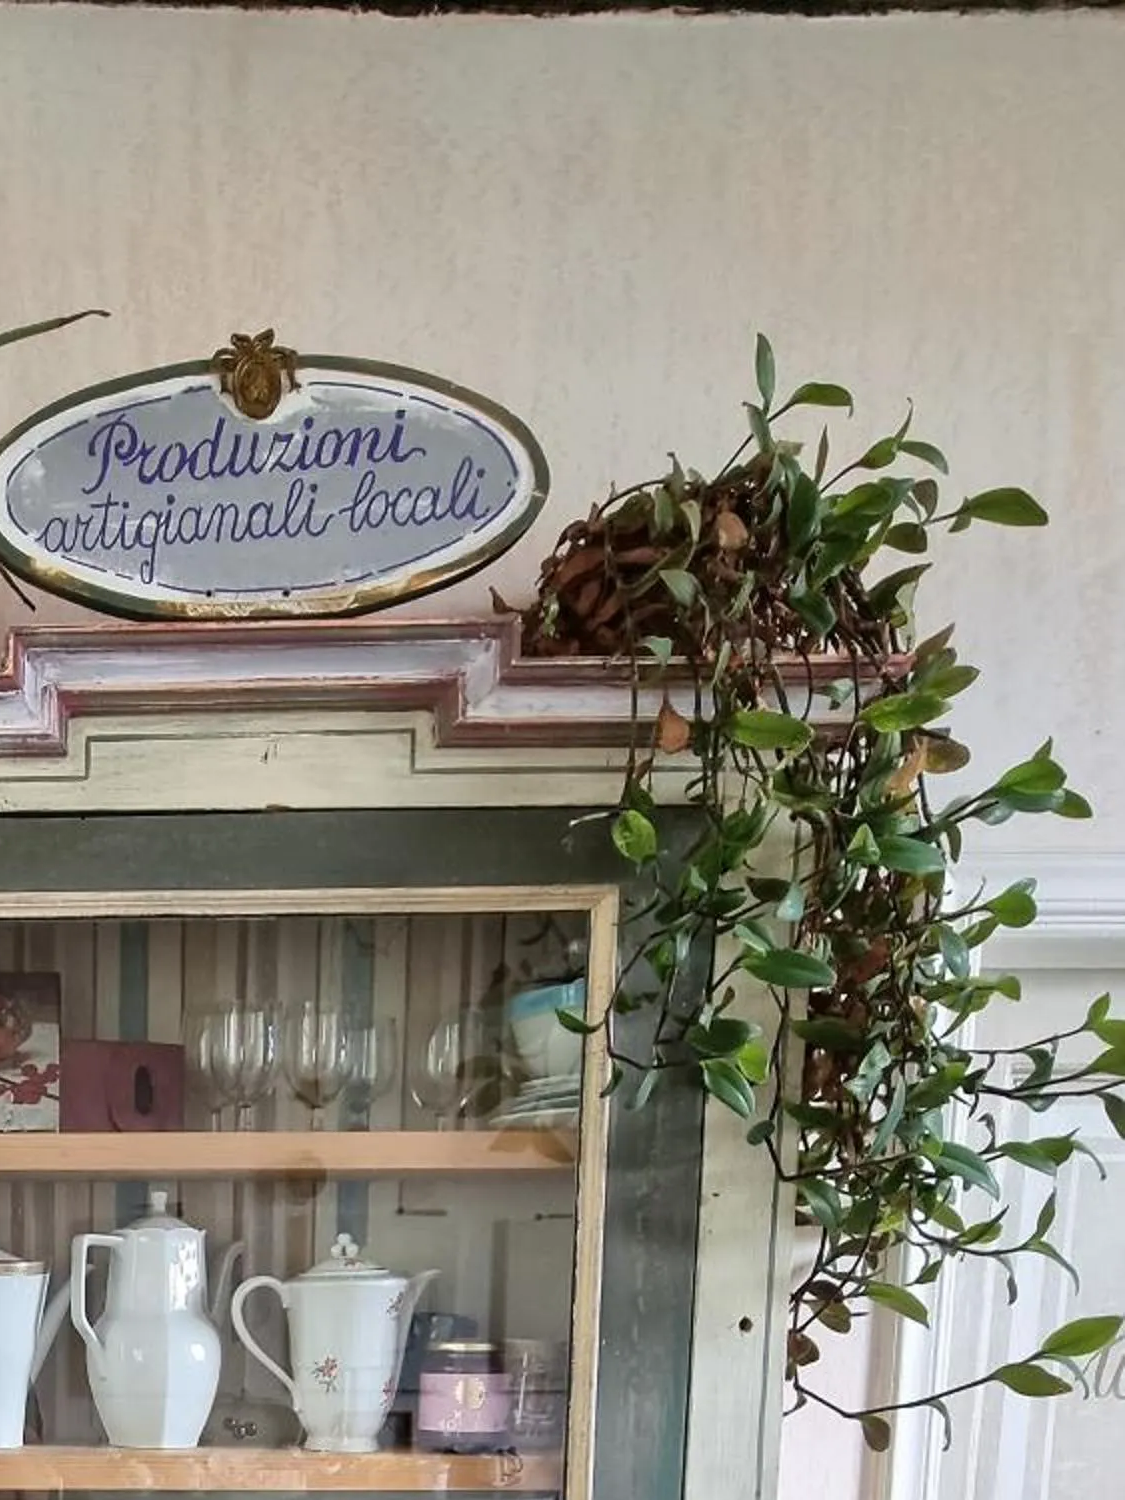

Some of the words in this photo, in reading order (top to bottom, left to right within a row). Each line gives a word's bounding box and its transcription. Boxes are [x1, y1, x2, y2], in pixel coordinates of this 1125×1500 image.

[82, 408, 426, 495] Produzioni
[37, 480, 334, 585] artigianali
[339, 456, 494, 534] locali
